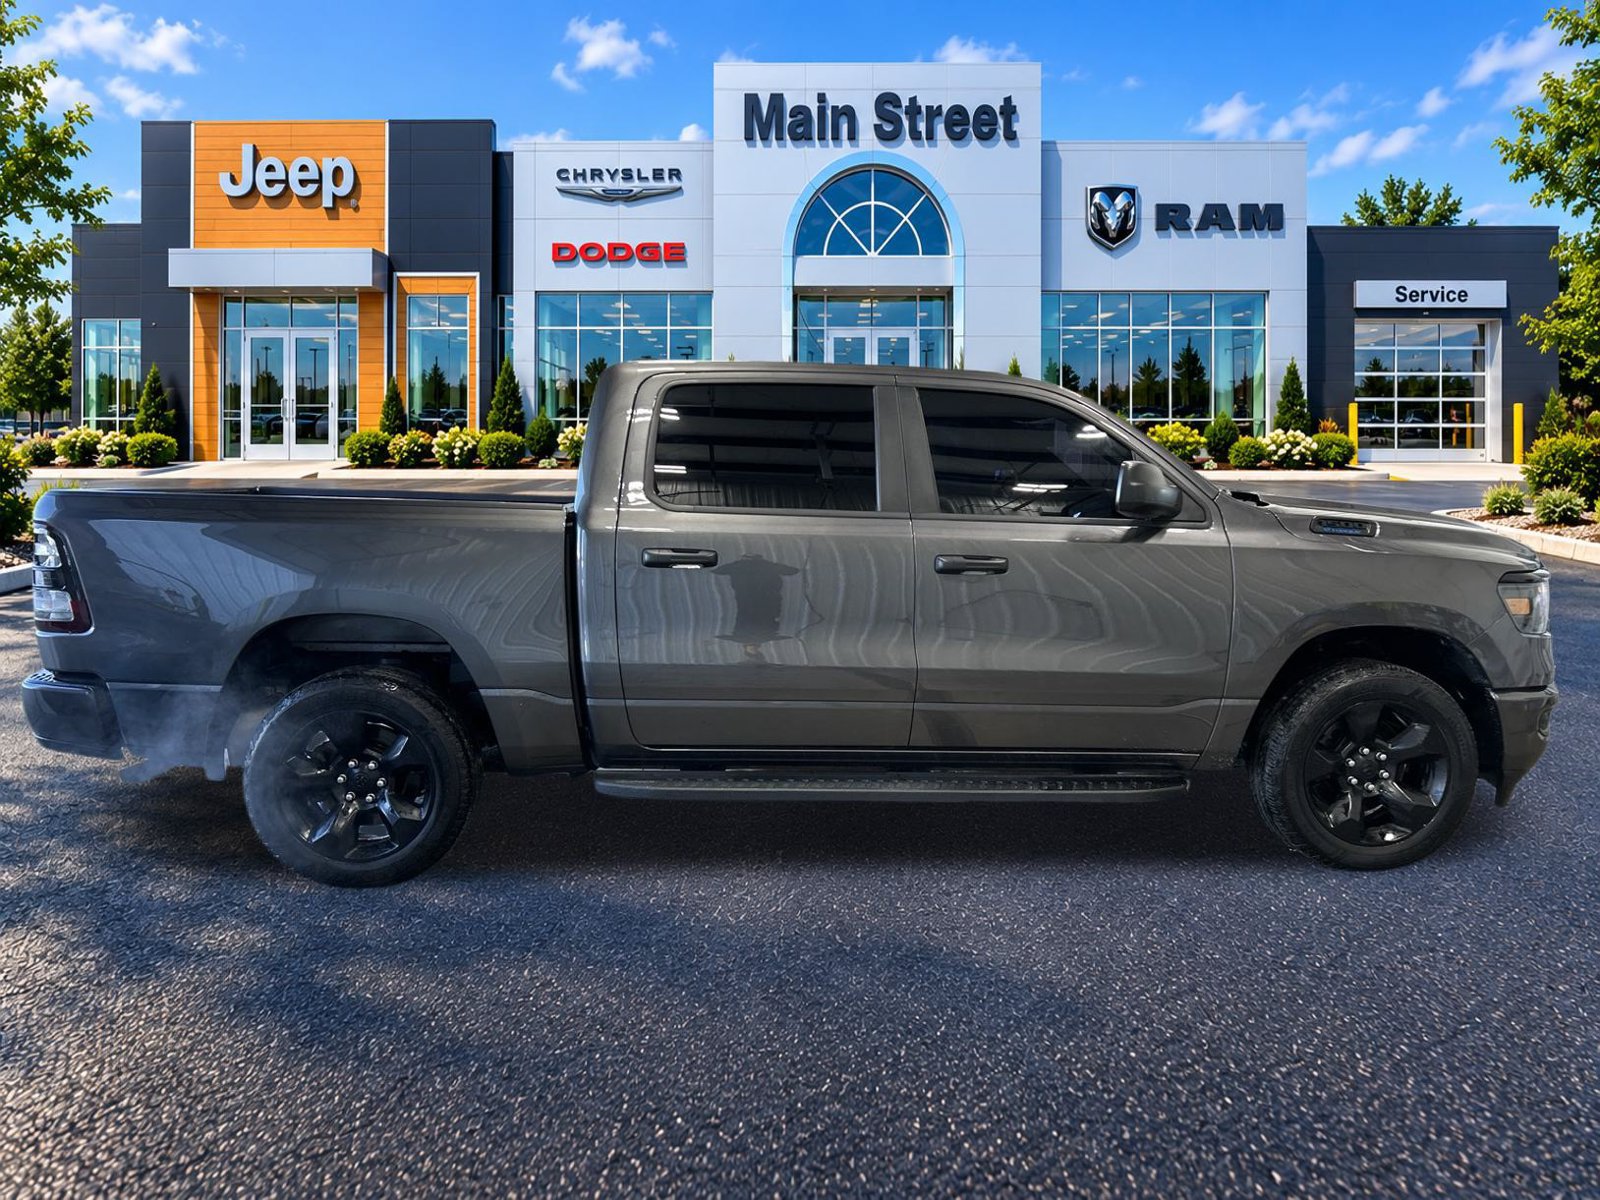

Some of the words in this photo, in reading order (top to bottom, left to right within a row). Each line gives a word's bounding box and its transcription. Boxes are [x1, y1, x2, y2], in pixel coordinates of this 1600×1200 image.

[744, 92, 857, 141] Main
[874, 92, 1018, 141] Street
[219, 143, 355, 208] Jeep
[556, 168, 682, 182] CHRYSLER
[1155, 203, 1284, 231] RAM
[552, 242, 686, 262] DODGE
[1395, 285, 1468, 303] Service
